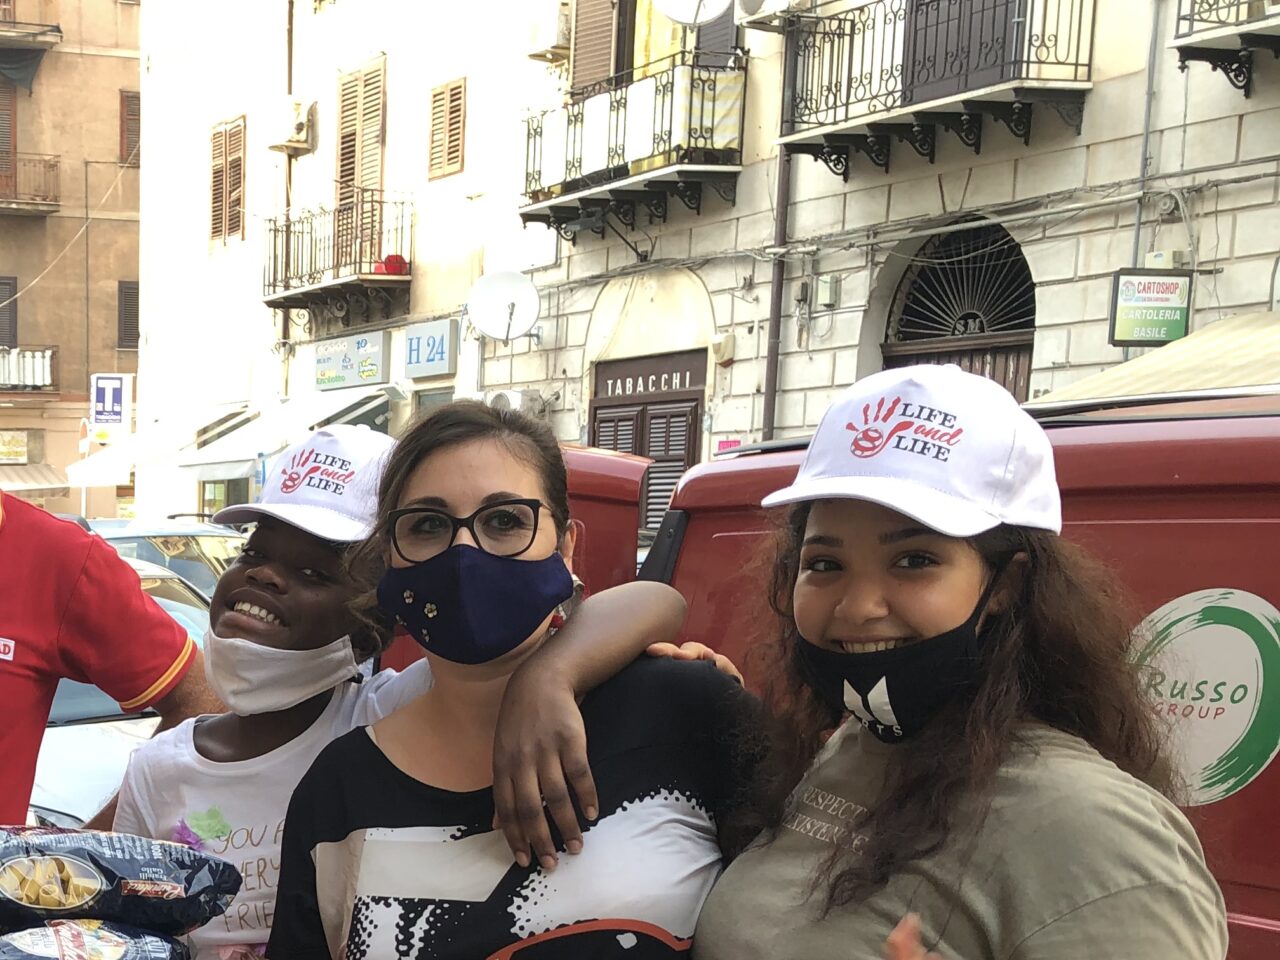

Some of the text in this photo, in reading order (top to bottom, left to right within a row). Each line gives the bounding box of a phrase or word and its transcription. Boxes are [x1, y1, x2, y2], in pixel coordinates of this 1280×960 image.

[1137, 282, 1179, 294] CARTOSHOP
[1122, 309, 1180, 320] CARTOLERIA
[1133, 327, 1167, 337] BASILE
[407, 333, 445, 365] H 24
[607, 371, 690, 396] TABACCHI
[899, 402, 957, 429] LIFE
[914, 424, 963, 446] and
[892, 435, 950, 462] LIFE
[312, 453, 351, 472] LIFE
[305, 476, 345, 496] LIFE
[321, 468, 355, 484] and
[1145, 671, 1249, 705] Russo
[1152, 702, 1226, 720] GROUP
[802, 785, 868, 820] RESPECT
[213, 824, 267, 854] YOU
[783, 811, 869, 855] EXISTENE
[224, 901, 273, 933] FRIE
